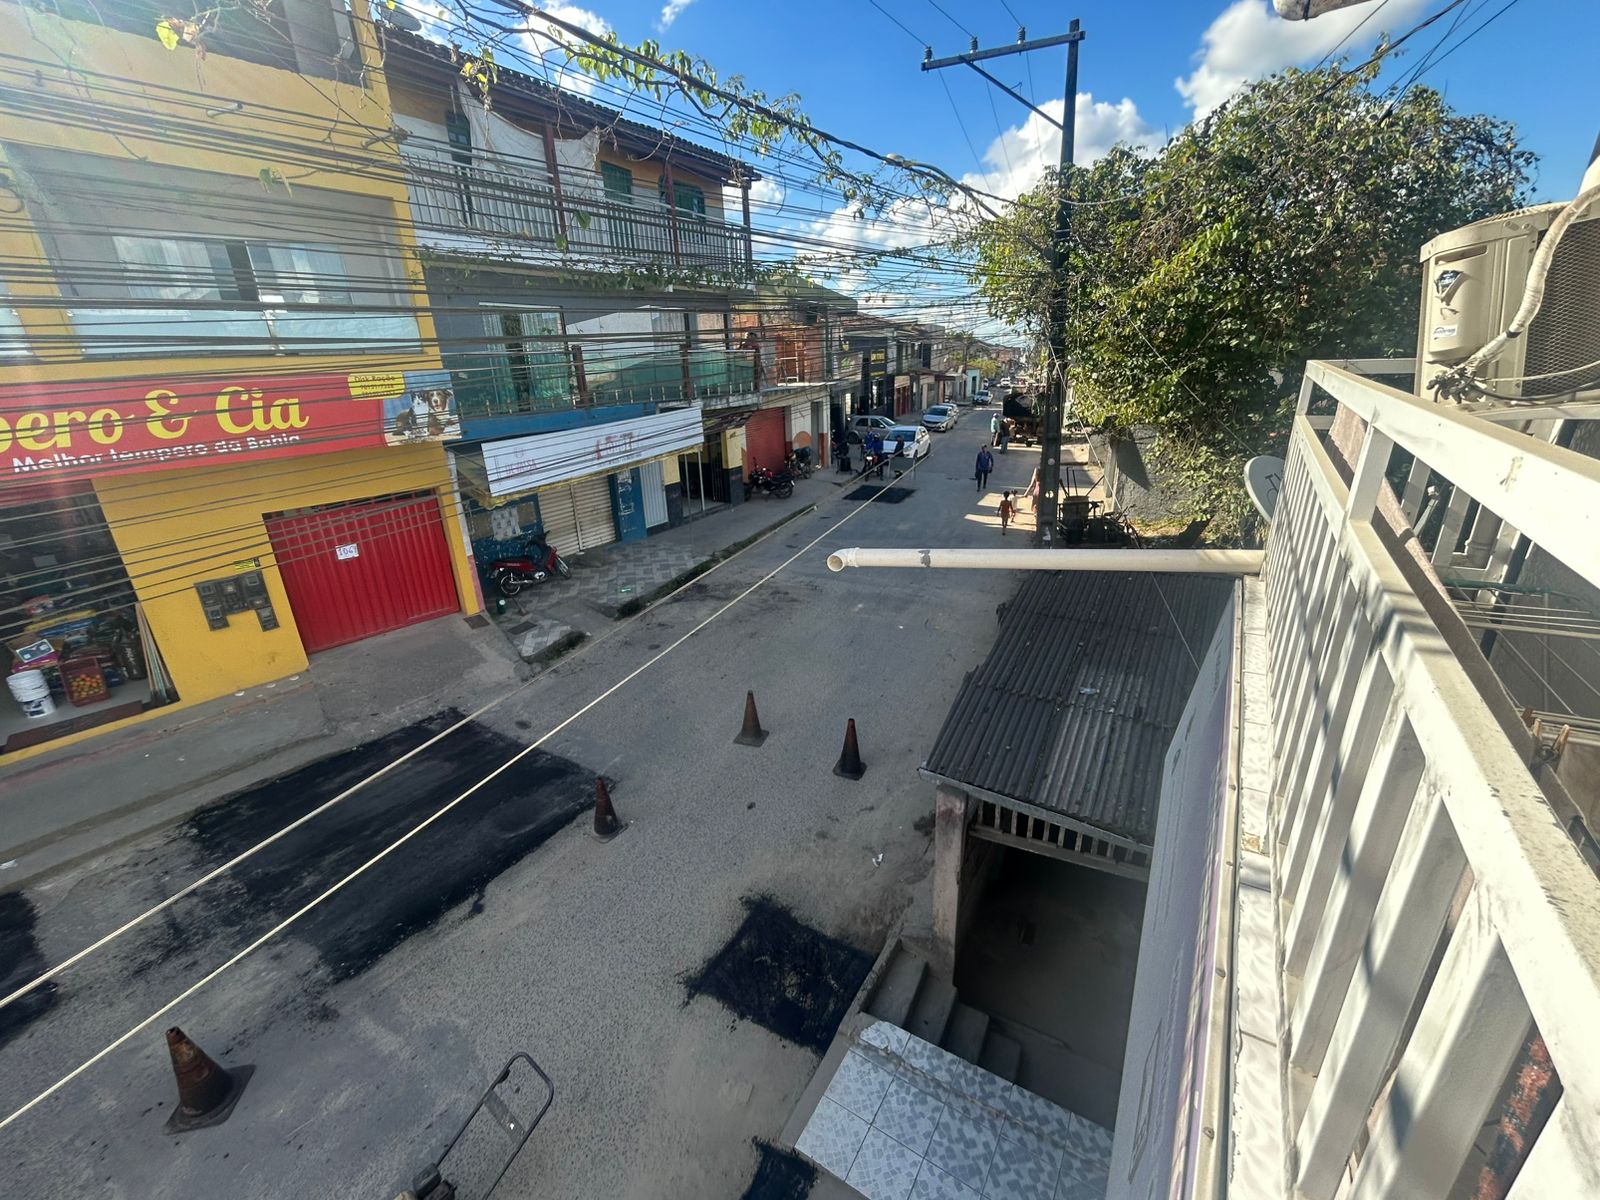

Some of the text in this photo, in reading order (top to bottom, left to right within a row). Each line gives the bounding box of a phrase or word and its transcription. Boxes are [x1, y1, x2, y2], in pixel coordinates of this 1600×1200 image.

[144, 389, 199, 440] &
[215, 386, 310, 434] Cia
[12, 432, 300, 473] Melhor tempero da Bahia
